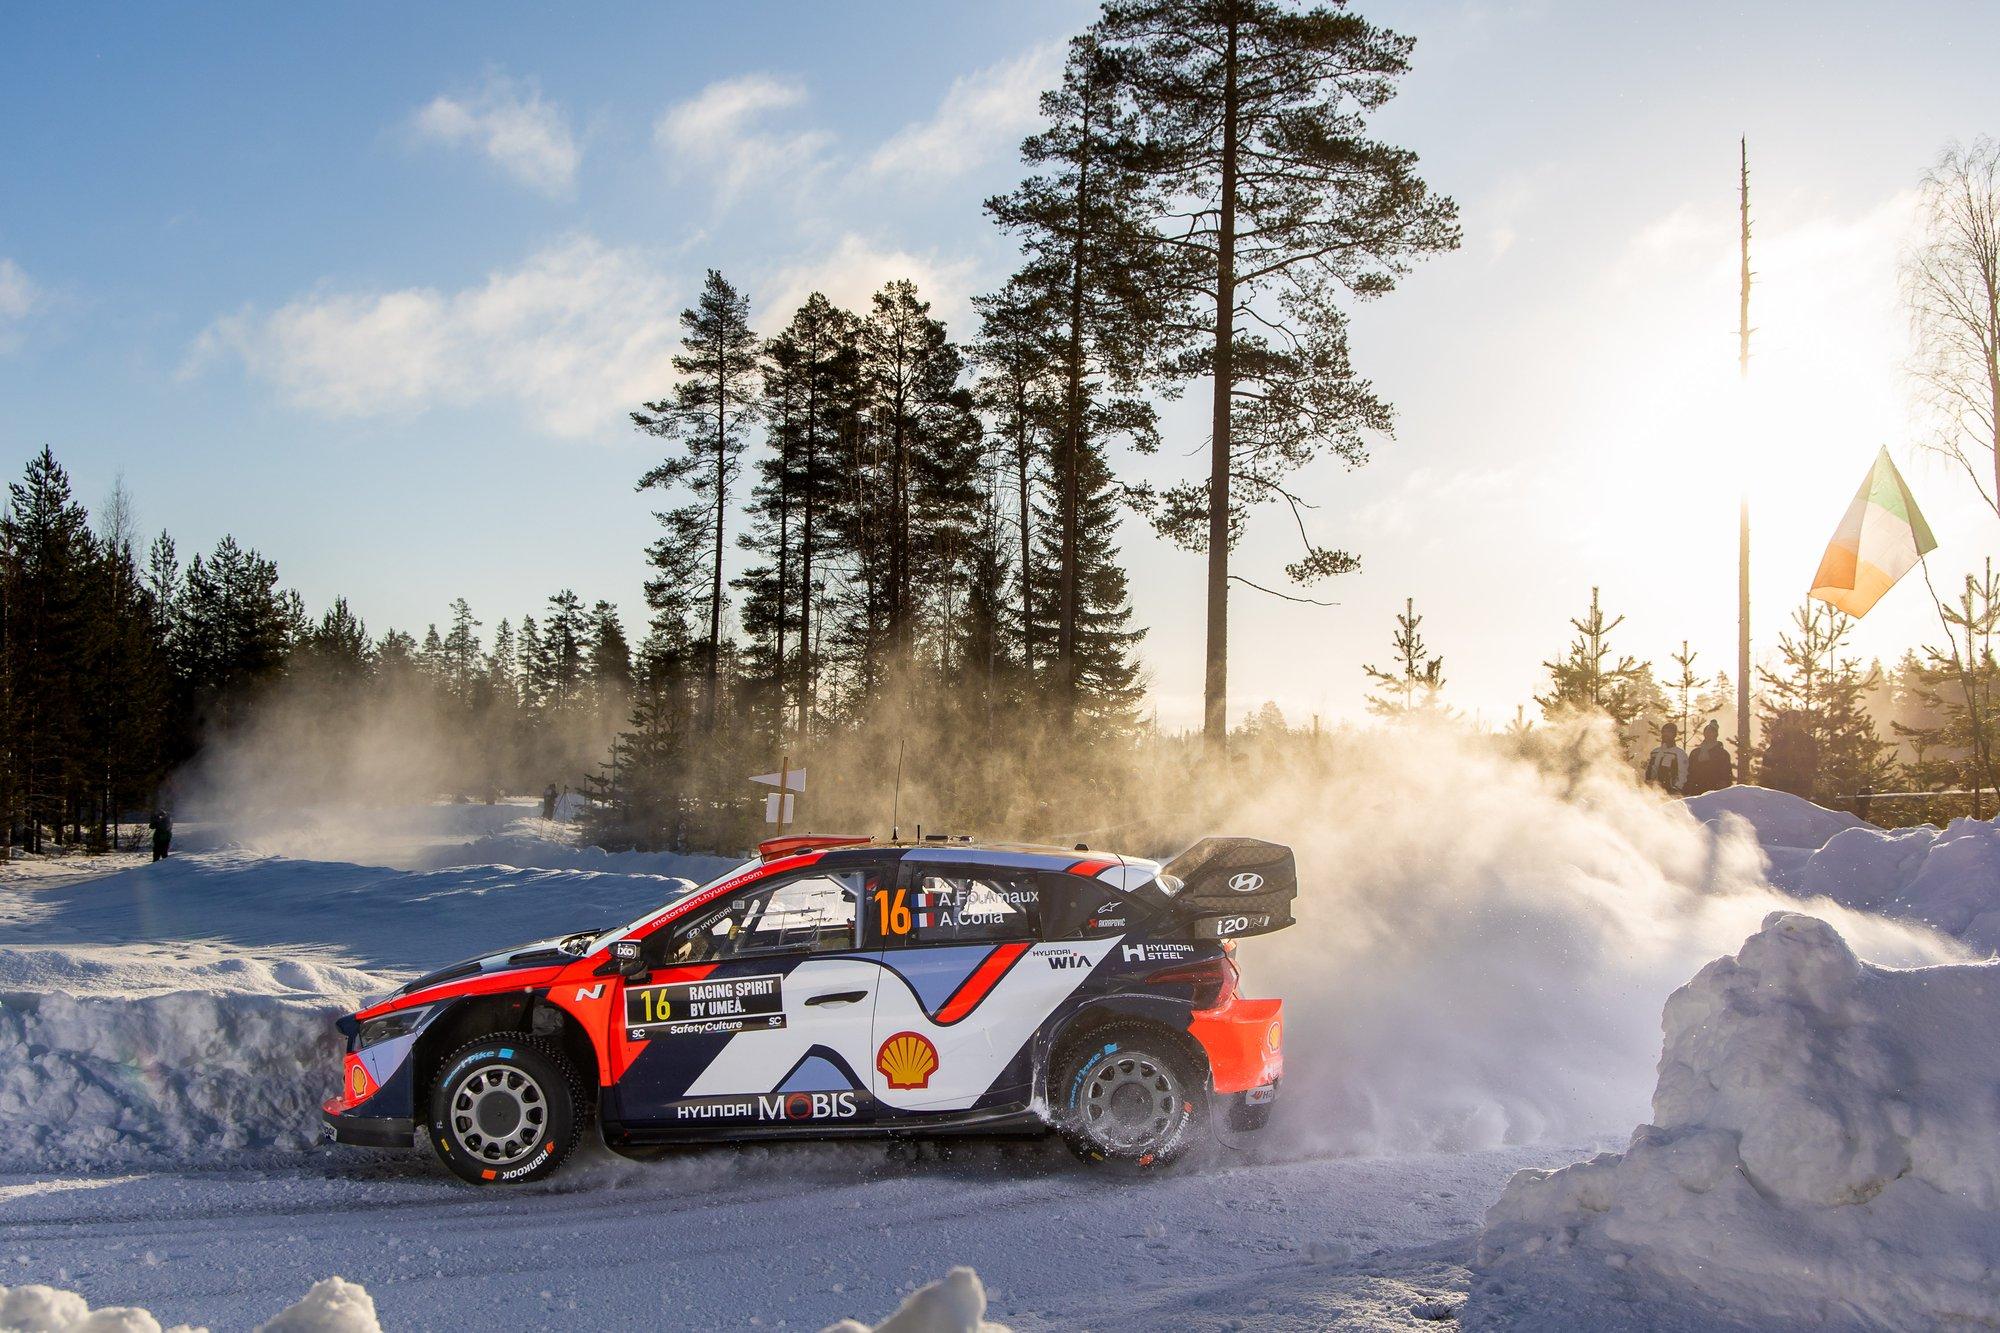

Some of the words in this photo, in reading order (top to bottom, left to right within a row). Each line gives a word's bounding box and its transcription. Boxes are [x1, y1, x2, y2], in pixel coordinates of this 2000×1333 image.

[652, 870, 764, 928] motorsport.hyundai.com
[700, 906, 733, 931] HYUNDAI
[874, 888, 912, 936] 16
[1216, 916, 1249, 935] i20
[617, 943, 634, 956] ixo
[1033, 949, 1071, 957] HYUNDAI
[1146, 944, 1194, 952] HYUNDAI
[1147, 952, 1183, 960] STEEL
[689, 983, 733, 1000] RACING
[735, 980, 774, 997] SPIRIT
[640, 988, 670, 1021] 16
[689, 1003, 705, 1017] BY
[708, 997, 746, 1016] UMEÅ.
[670, 1020, 743, 1035] SafetyCulture
[769, 1016, 782, 1026] SC
[632, 1028, 646, 1038] SC
[677, 1103, 752, 1119] HYUNDAI
[758, 1092, 857, 1121] MOBIS
